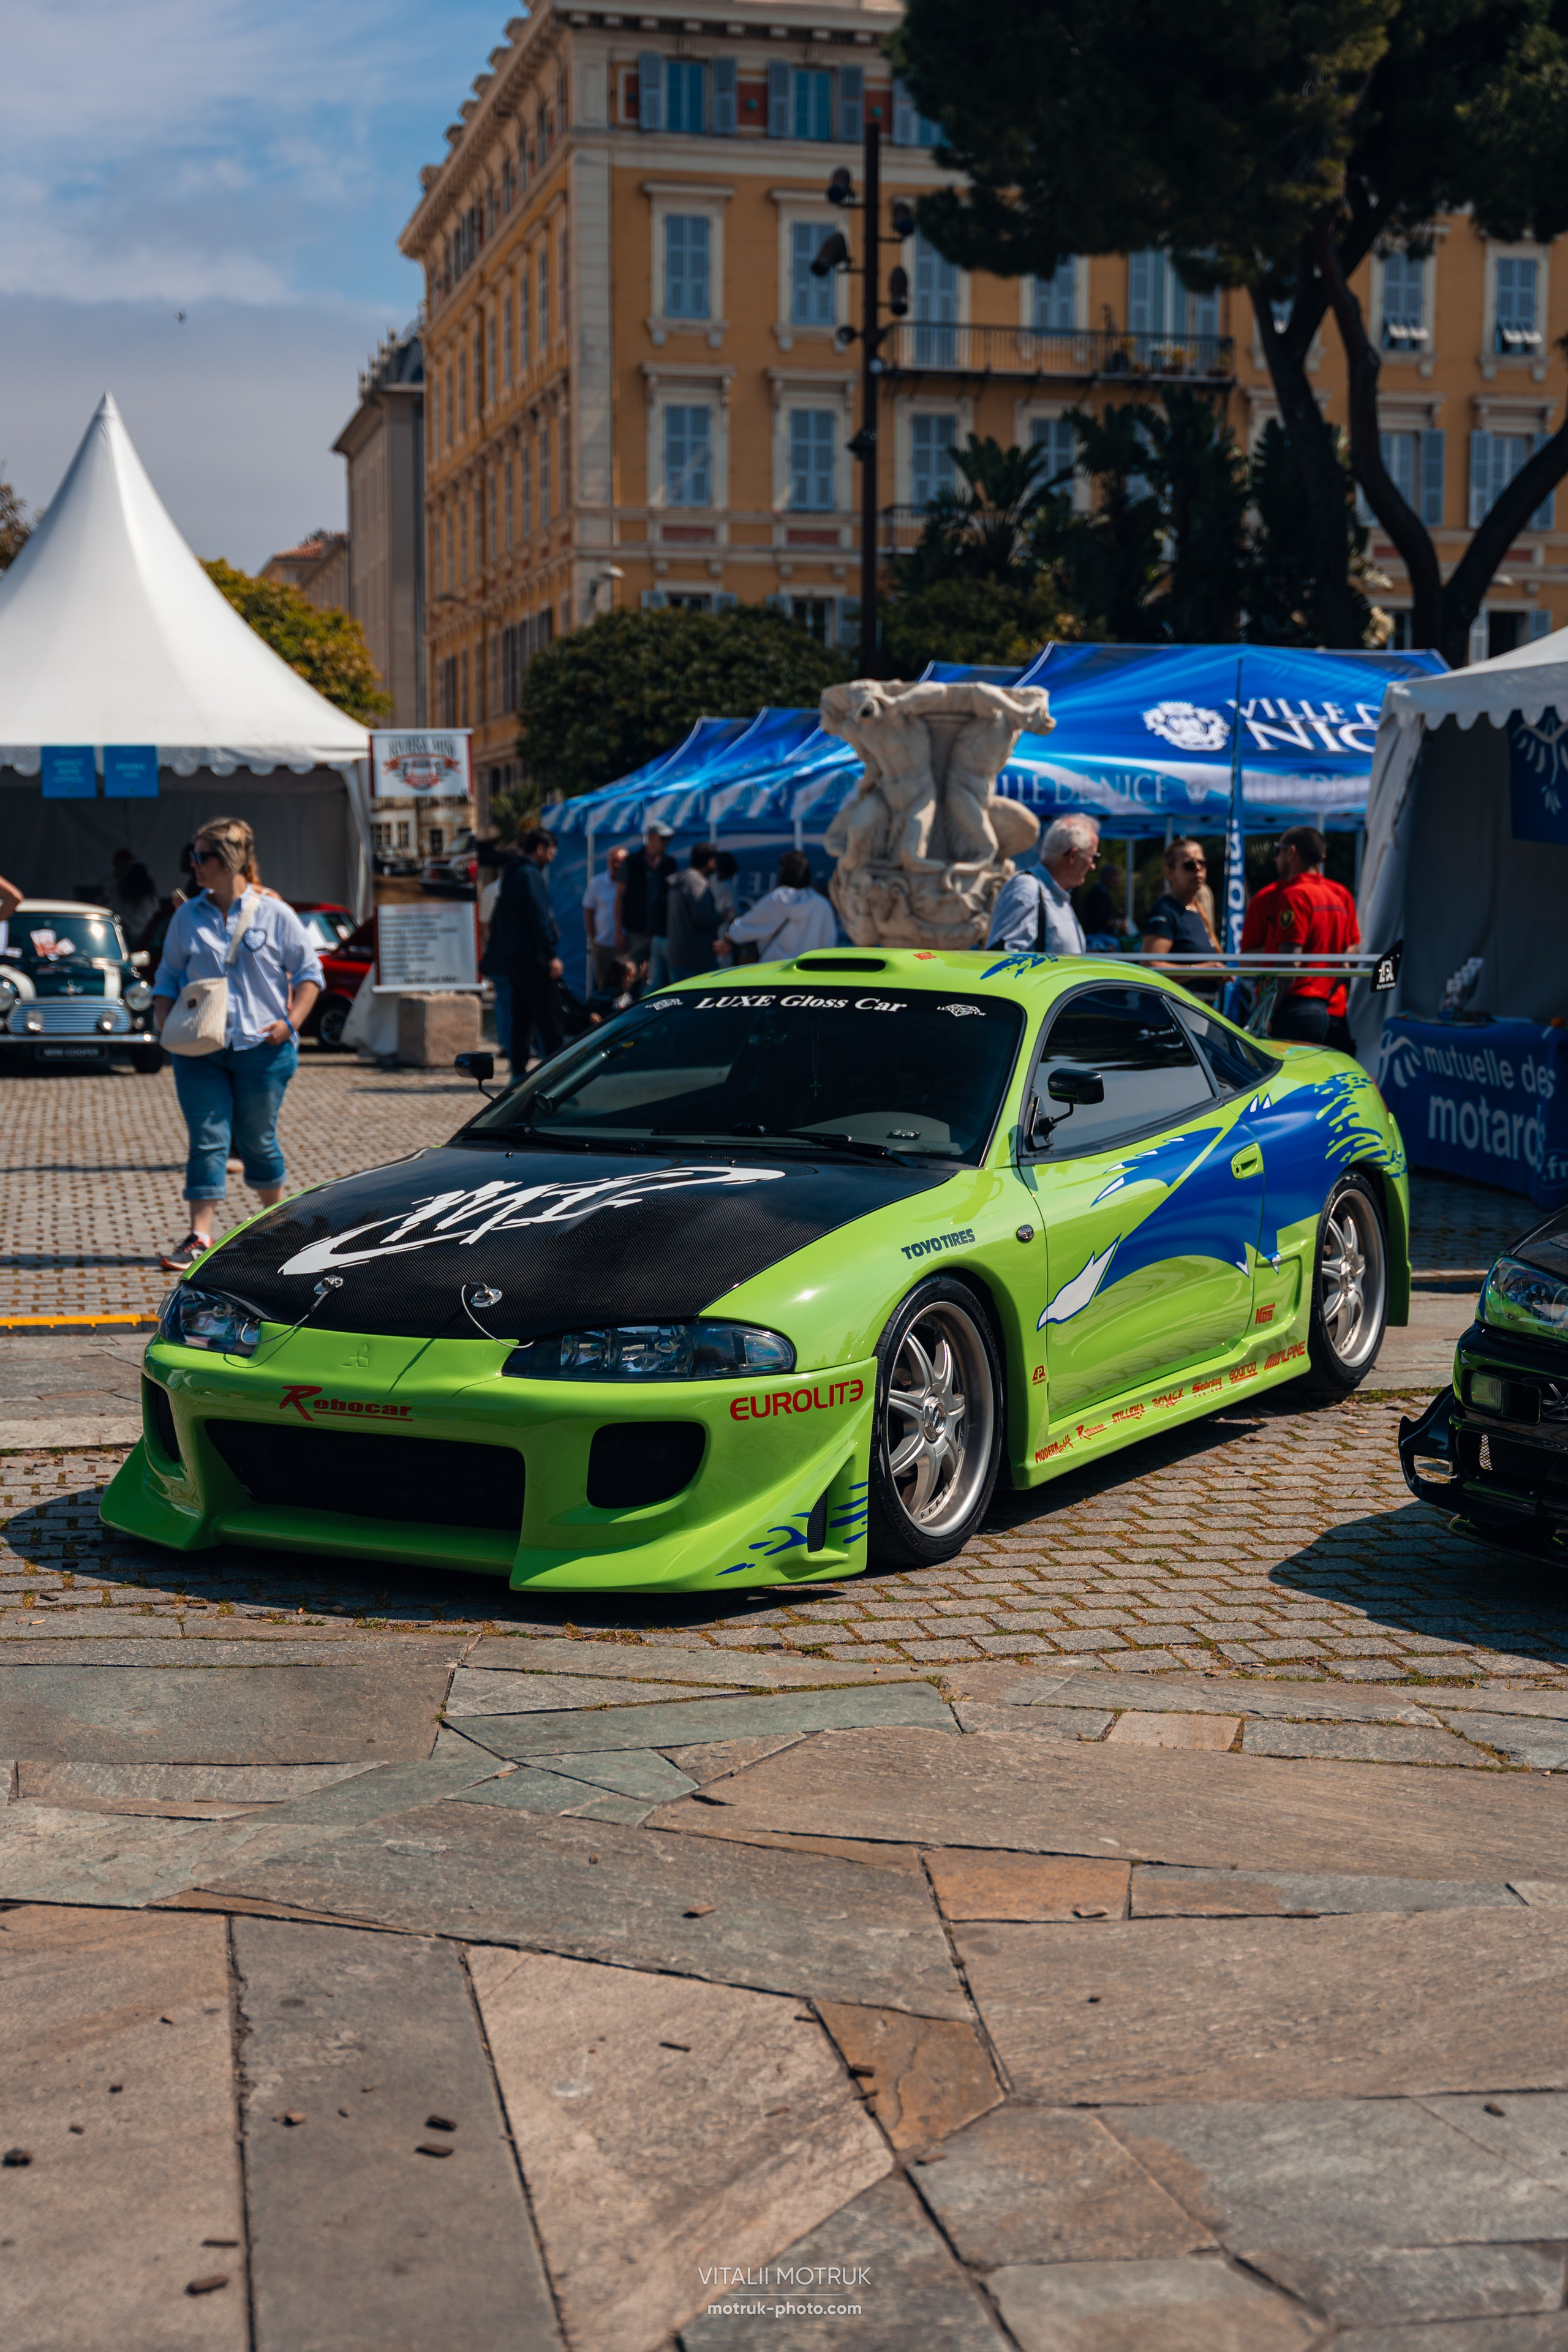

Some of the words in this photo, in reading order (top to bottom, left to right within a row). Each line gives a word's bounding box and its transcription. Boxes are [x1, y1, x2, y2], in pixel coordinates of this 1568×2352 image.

[1226, 697, 1350, 724] VILLE
[389, 737, 428, 758] RIVIERA
[1245, 719, 1379, 753] NIC
[1099, 774, 1169, 804] NICE
[694, 995, 777, 1009] LUXE
[780, 995, 849, 1008] Gloss
[854, 998, 908, 1012] Car
[1423, 1045, 1514, 1090] mutuelle
[1521, 1055, 1556, 1099] des
[1229, 1361, 1257, 1381] sparco
[1193, 1377, 1223, 1394] Sebring
[279, 1385, 412, 1422] Robocar
